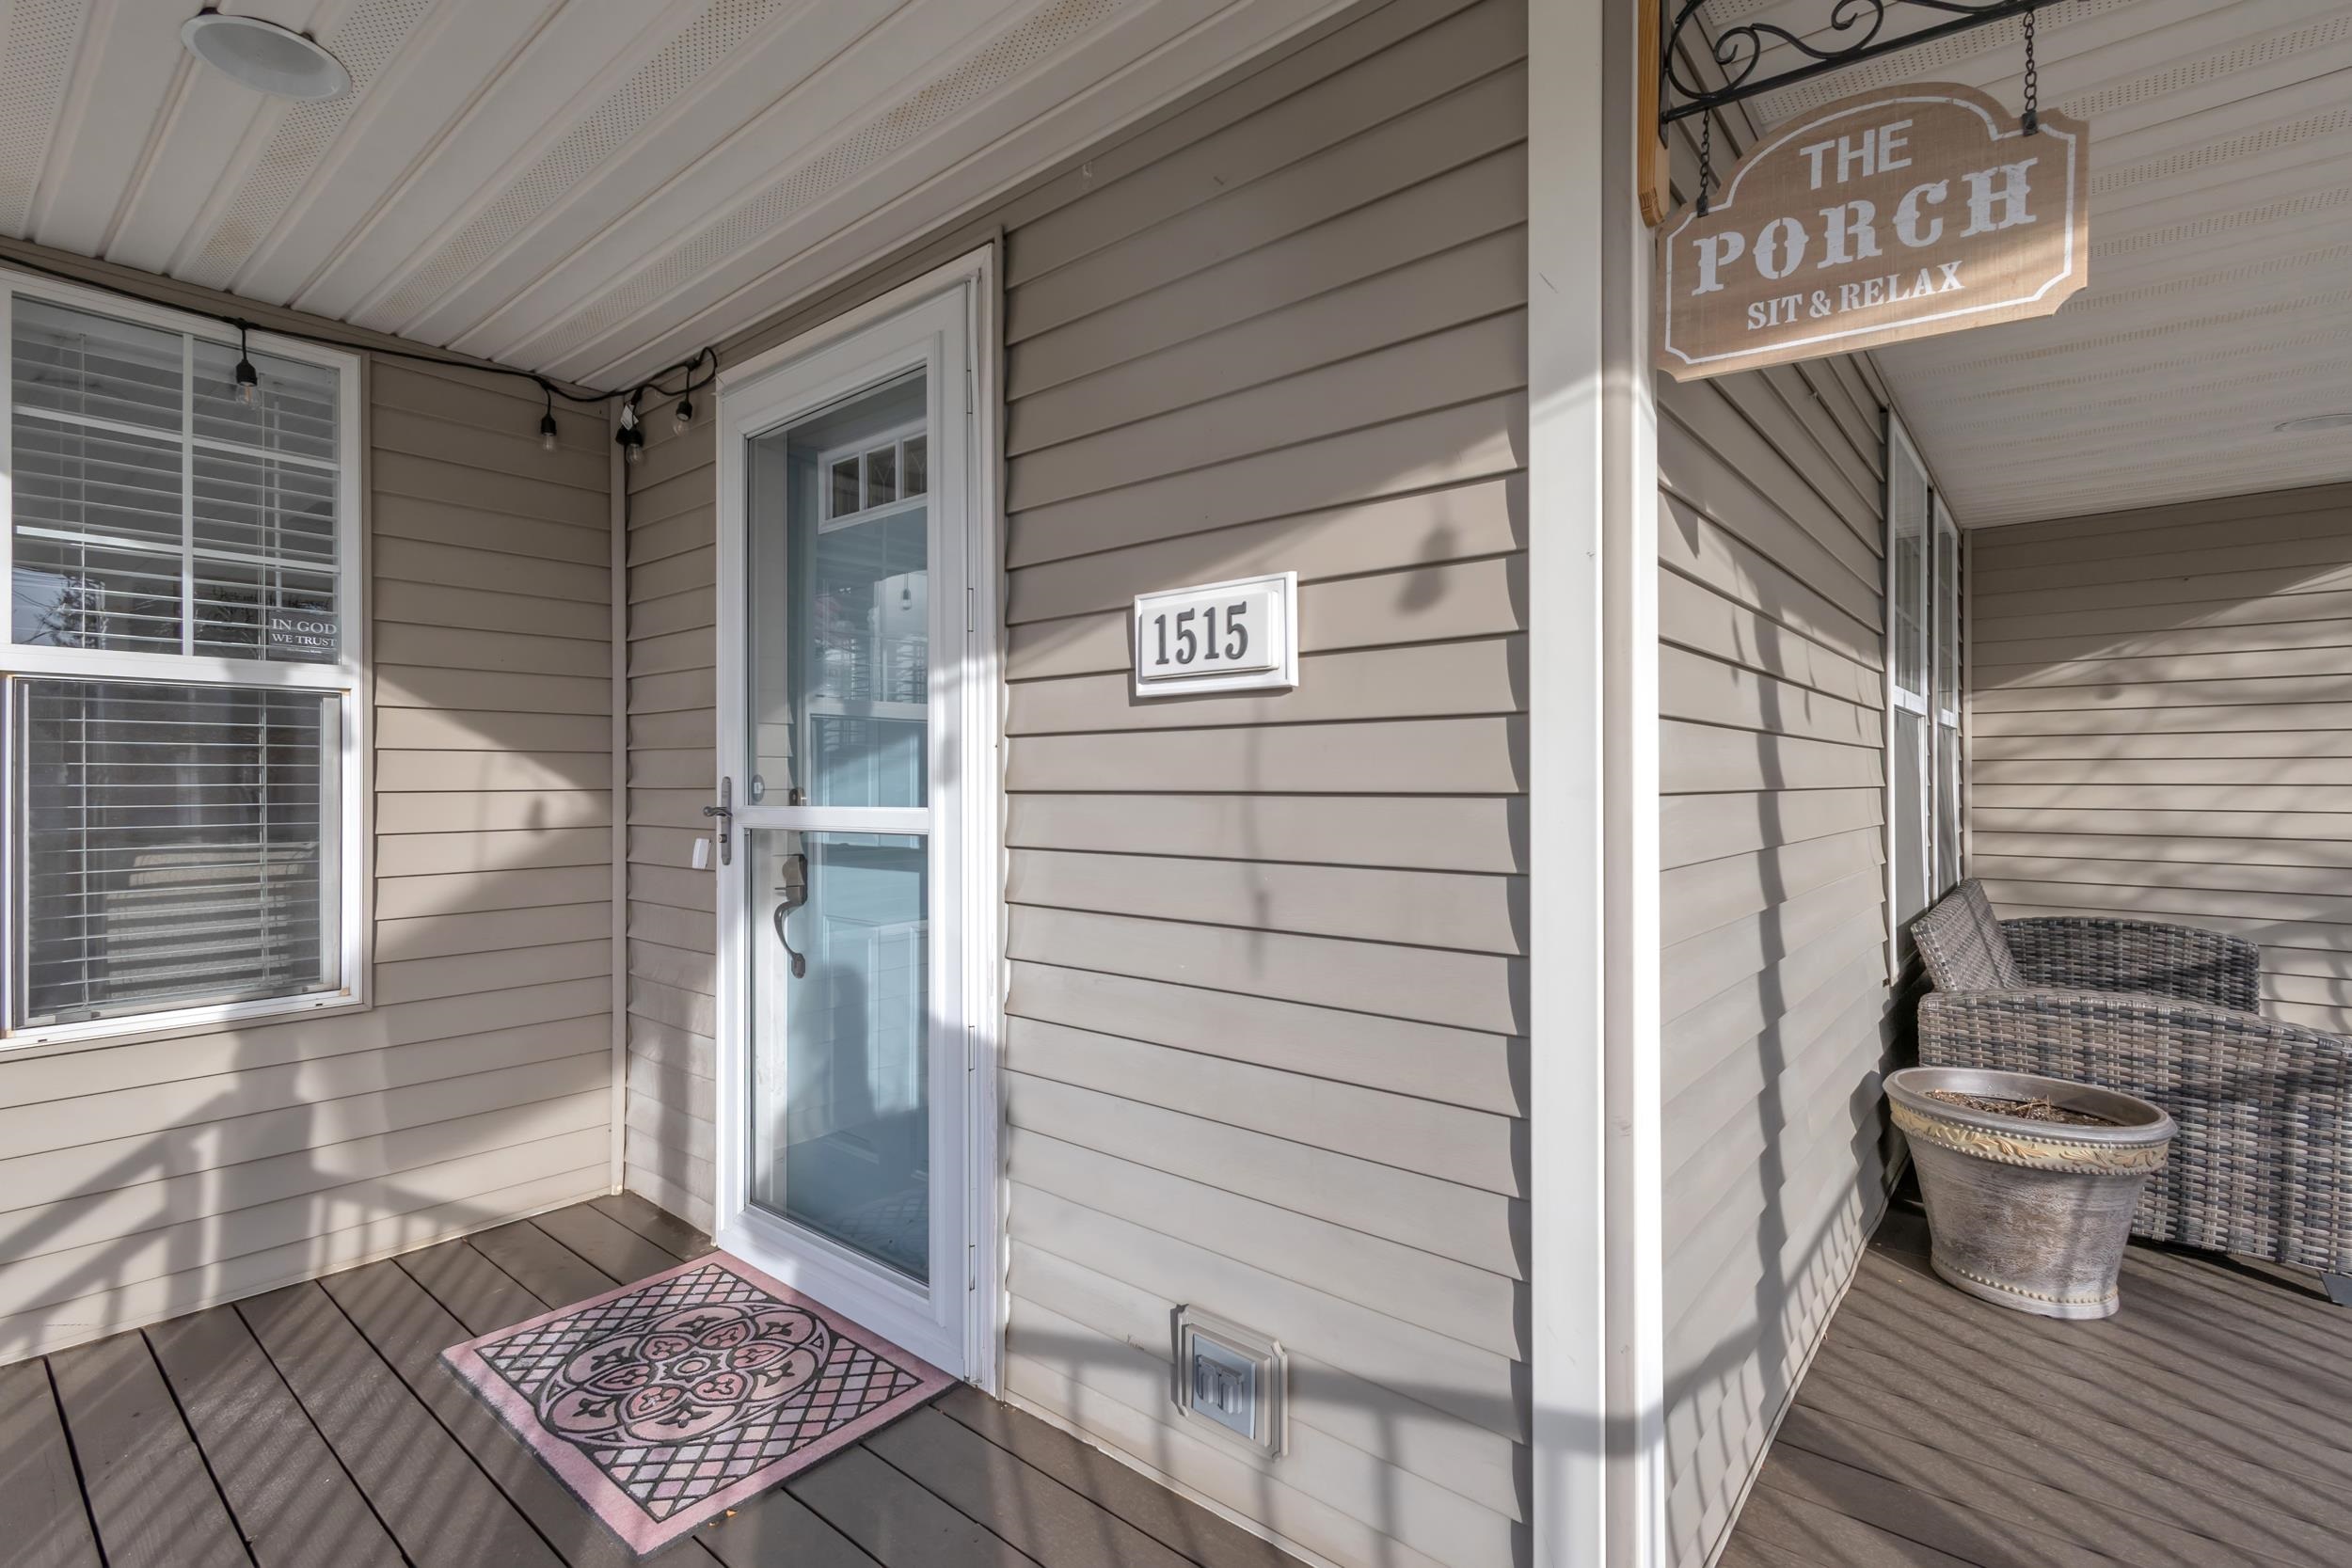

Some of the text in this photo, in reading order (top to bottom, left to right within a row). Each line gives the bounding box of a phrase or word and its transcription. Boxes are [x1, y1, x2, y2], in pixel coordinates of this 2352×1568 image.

[1799, 119, 1914, 190] THE
[1691, 157, 2040, 297] PORCH
[1747, 260, 1965, 331] SIT & RELAX
[272, 618, 337, 635] IN GOD
[272, 633, 338, 647] WE TRUST
[1154, 601, 1248, 665] 1515
